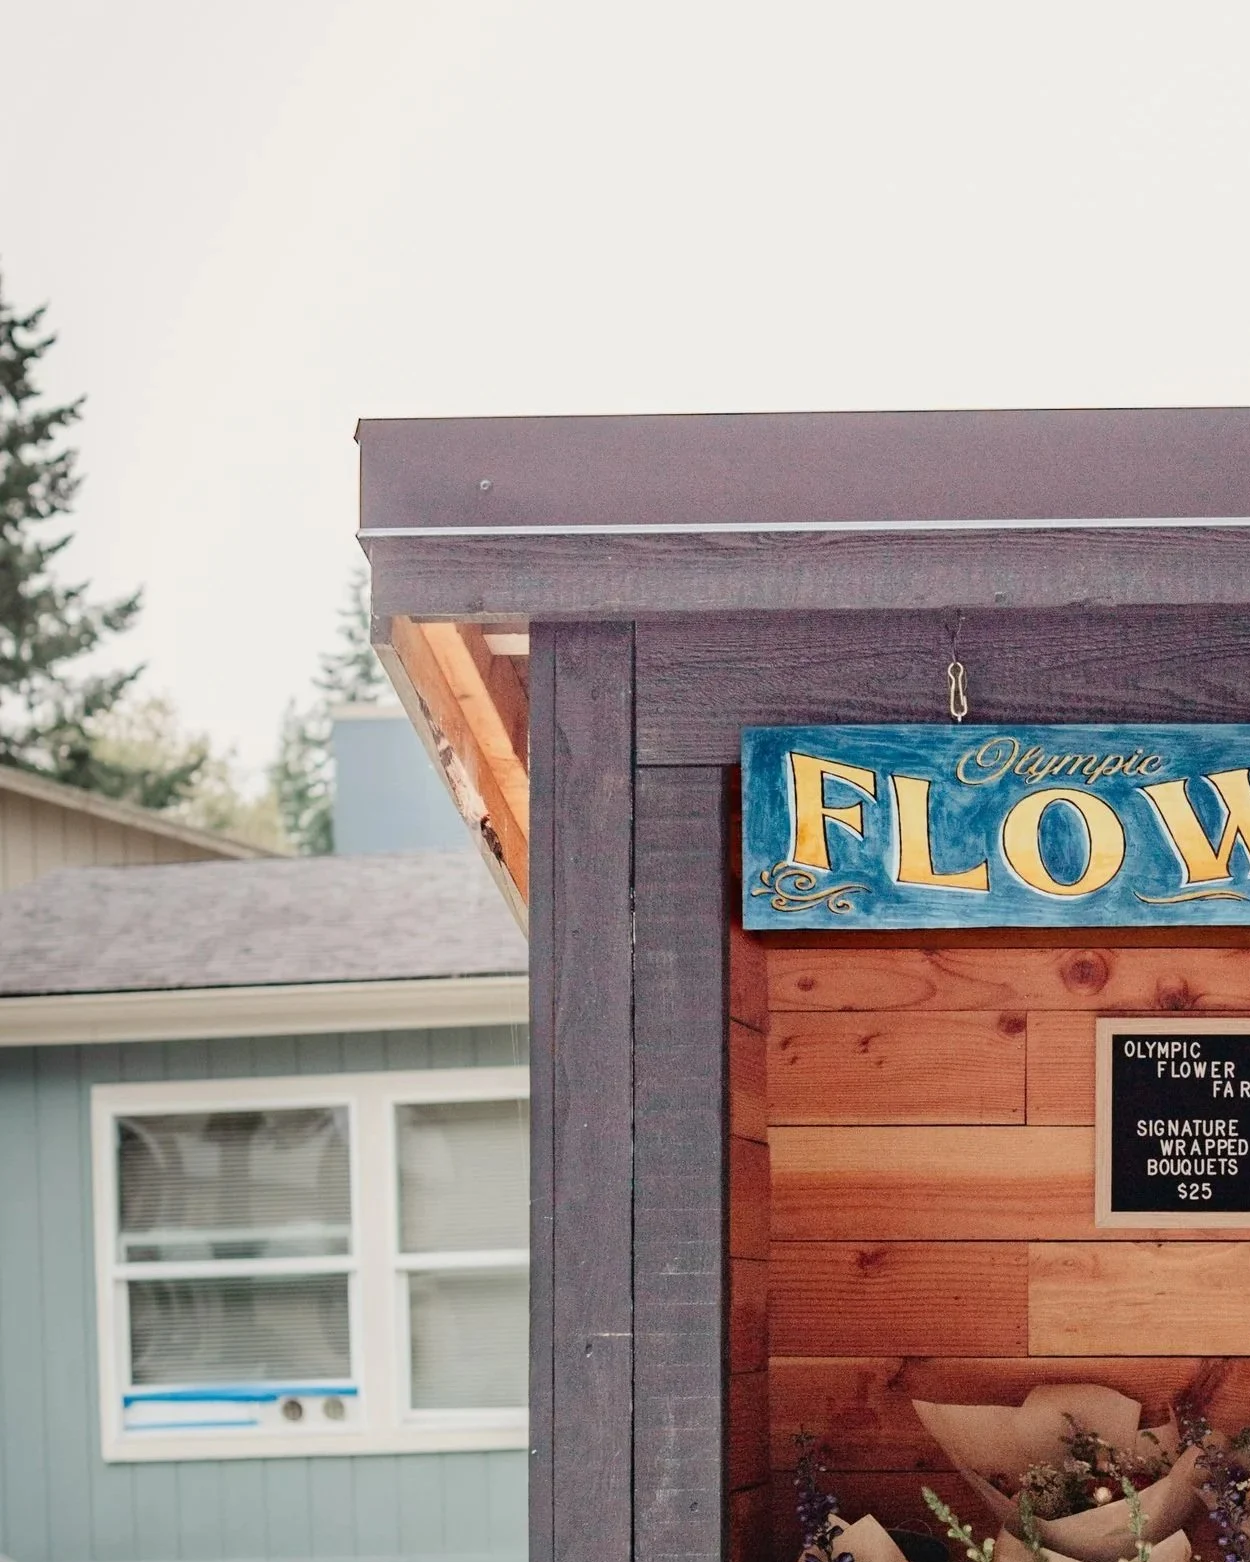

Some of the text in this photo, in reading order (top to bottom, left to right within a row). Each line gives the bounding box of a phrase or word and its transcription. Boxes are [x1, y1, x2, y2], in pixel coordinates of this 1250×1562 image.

[956, 736, 1166, 785] Olympic
[1124, 1040, 1201, 1059] OLYMPIC
[1157, 1061, 1236, 1079] FLOWER
[1136, 1119, 1239, 1137] SIGNATURE
[1160, 1139, 1249, 1156] WRAPPED
[1147, 1158, 1239, 1176] BOUQUETS
[1177, 1182, 1212, 1200] $25
